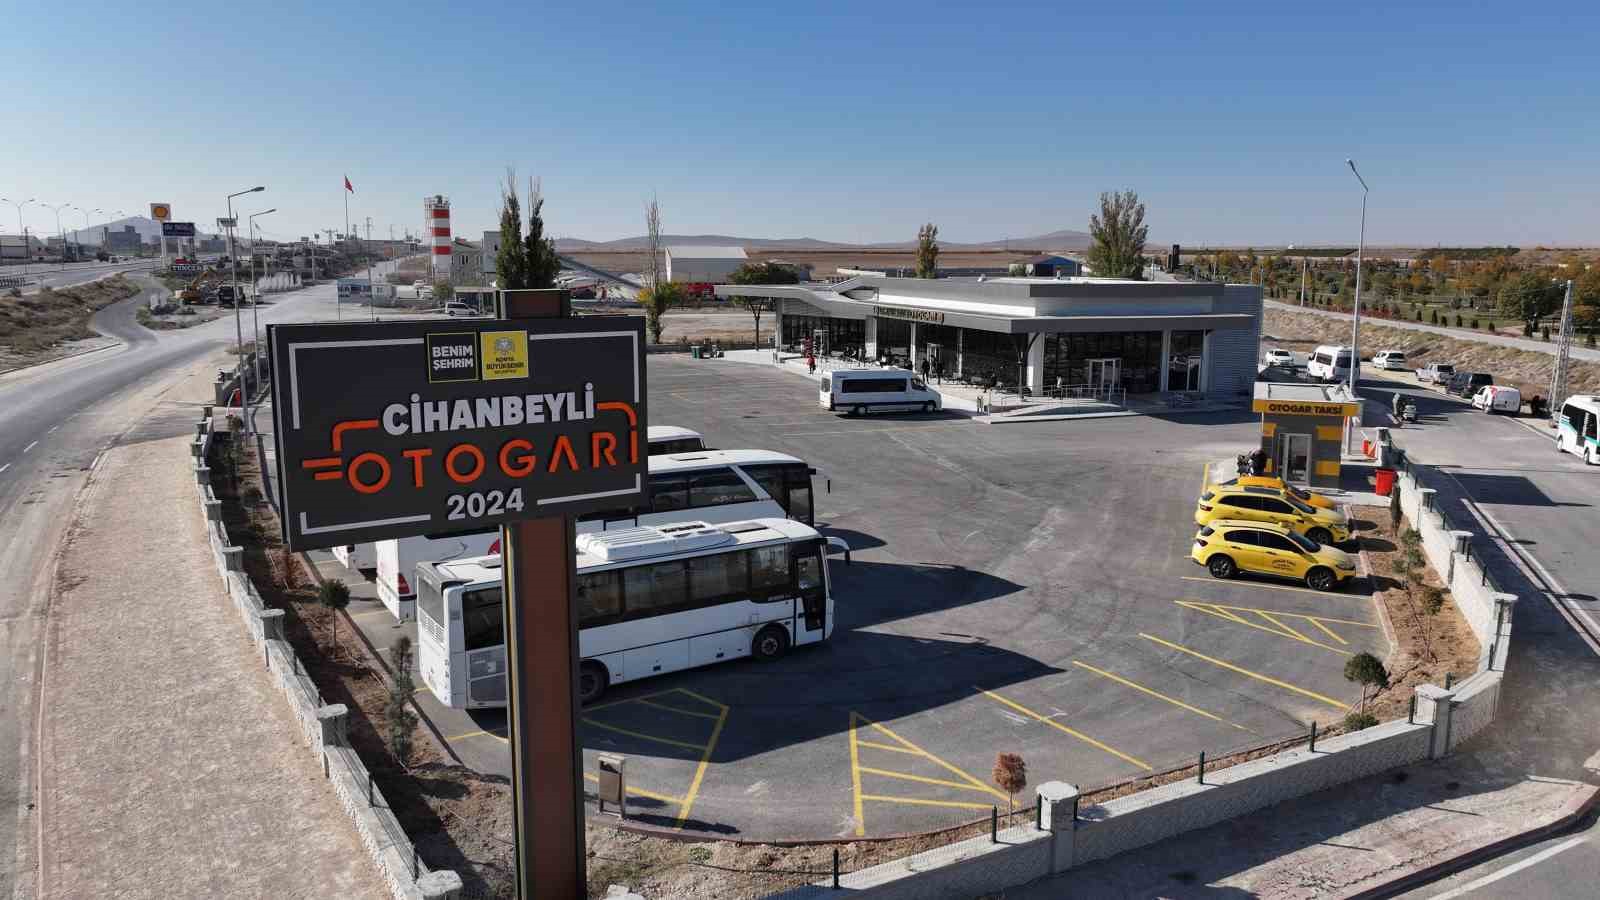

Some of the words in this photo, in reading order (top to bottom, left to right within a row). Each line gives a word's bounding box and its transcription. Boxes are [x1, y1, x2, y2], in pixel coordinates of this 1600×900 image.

[432, 345, 473, 357] BENİM
[433, 358, 474, 371] ŞEHRİM
[382, 382, 594, 436] CİHANBEYLİ
[1269, 404, 1312, 413] OTOGAR
[1313, 405, 1343, 414] TAKSİ
[447, 487, 524, 521] 2024
